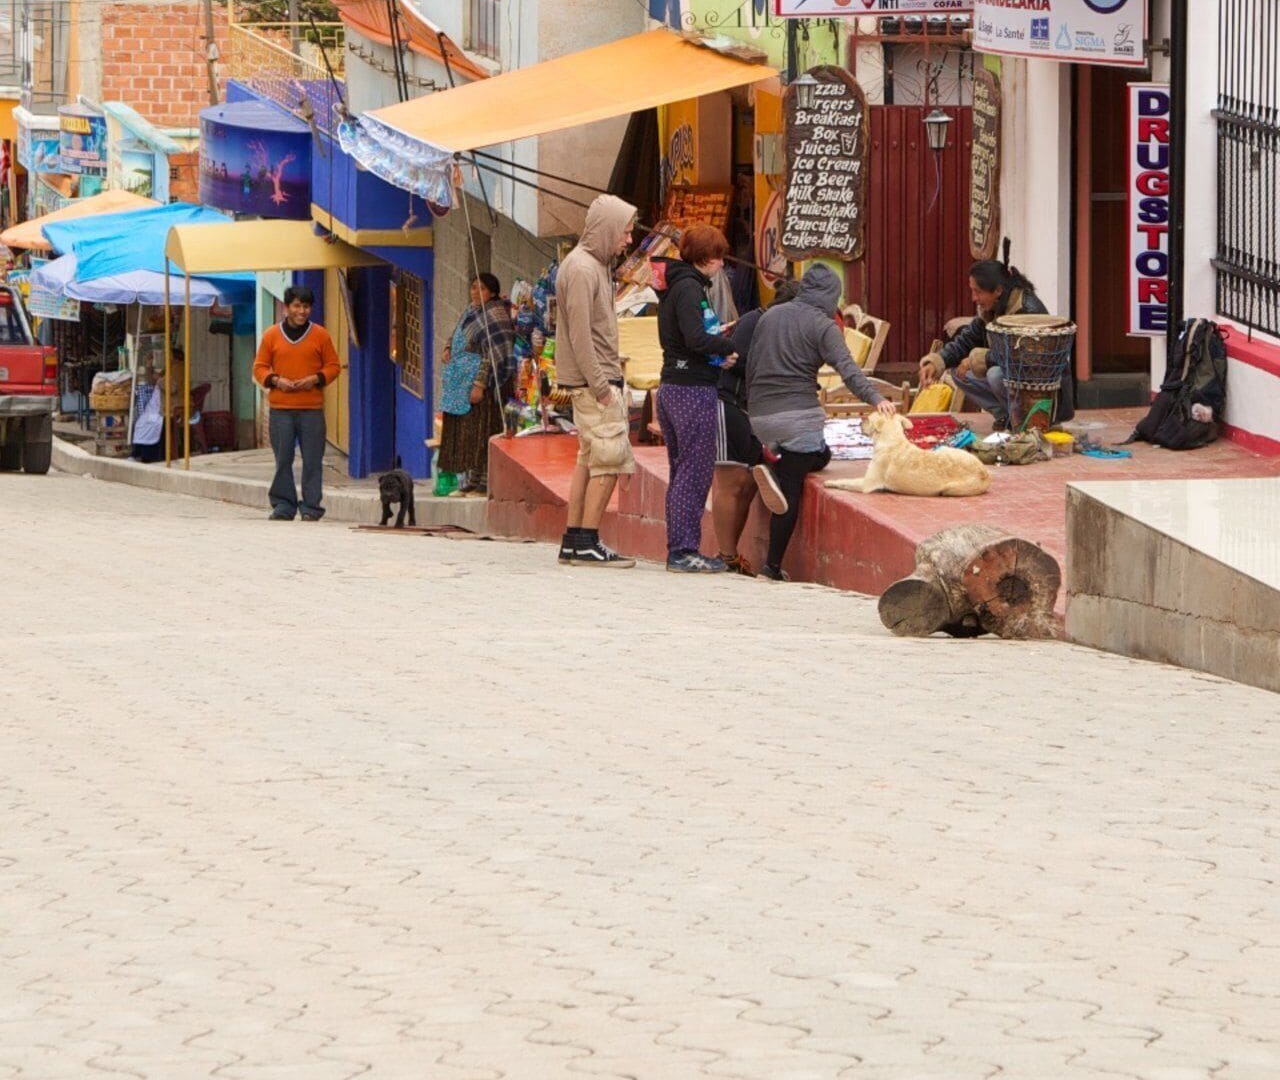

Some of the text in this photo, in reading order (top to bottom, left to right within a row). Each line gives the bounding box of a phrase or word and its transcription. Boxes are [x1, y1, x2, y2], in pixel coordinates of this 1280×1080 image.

[1075, 36, 1106, 47] SIGMA
[814, 84, 846, 96] zzas
[794, 110, 862, 127] Breakfast
[812, 126, 839, 141] Box
[794, 140, 841, 156] Juices
[792, 156, 860, 174] Ice Cream
[791, 171, 852, 186] Ice Beer
[786, 186, 815, 202] Milk
[1136, 90, 1169, 331] DRUGSTORE
[785, 216, 849, 235] Pancakes
